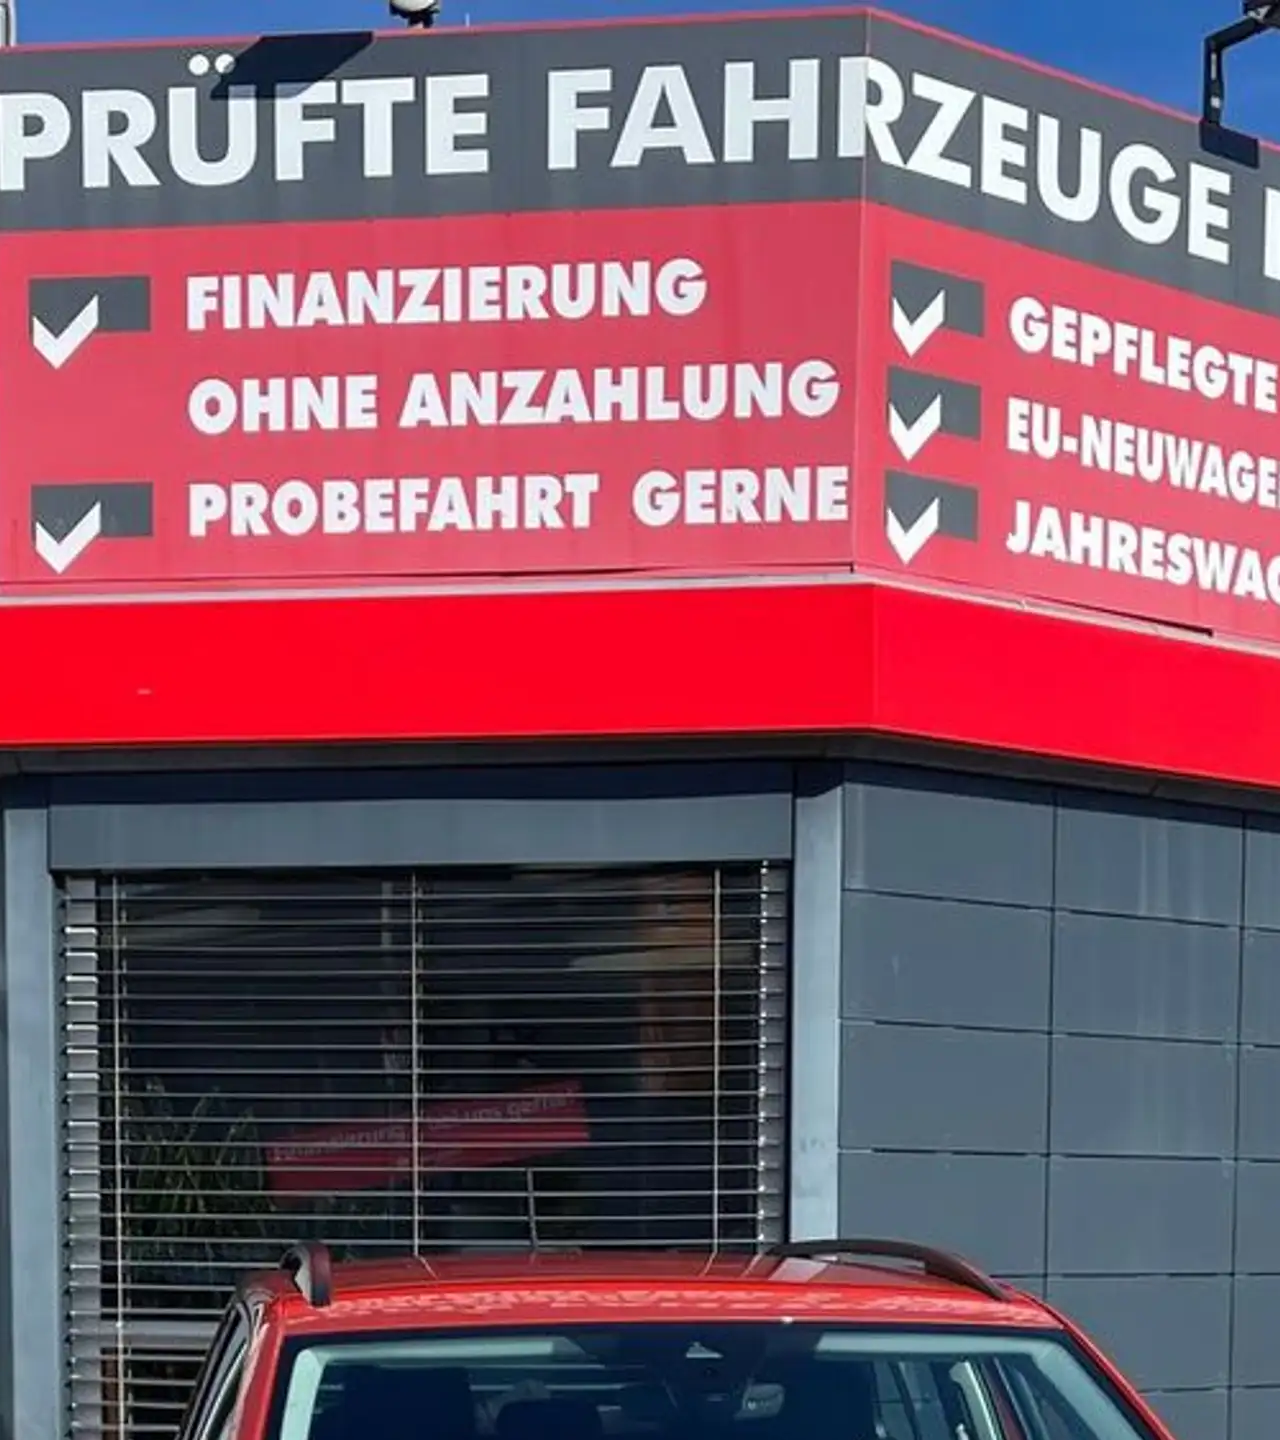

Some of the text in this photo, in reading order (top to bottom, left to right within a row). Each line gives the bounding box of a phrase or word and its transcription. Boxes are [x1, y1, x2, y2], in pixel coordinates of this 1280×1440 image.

[547, 55, 1233, 265] FAHRZEUGE
[186, 258, 708, 331] FINANZIERUNG
[1009, 295, 1278, 415] GEPFLEGTE
[187, 360, 840, 436] OHNE ANZAHLUNG
[187, 466, 850, 538] PROBEFAHRT GERNE
